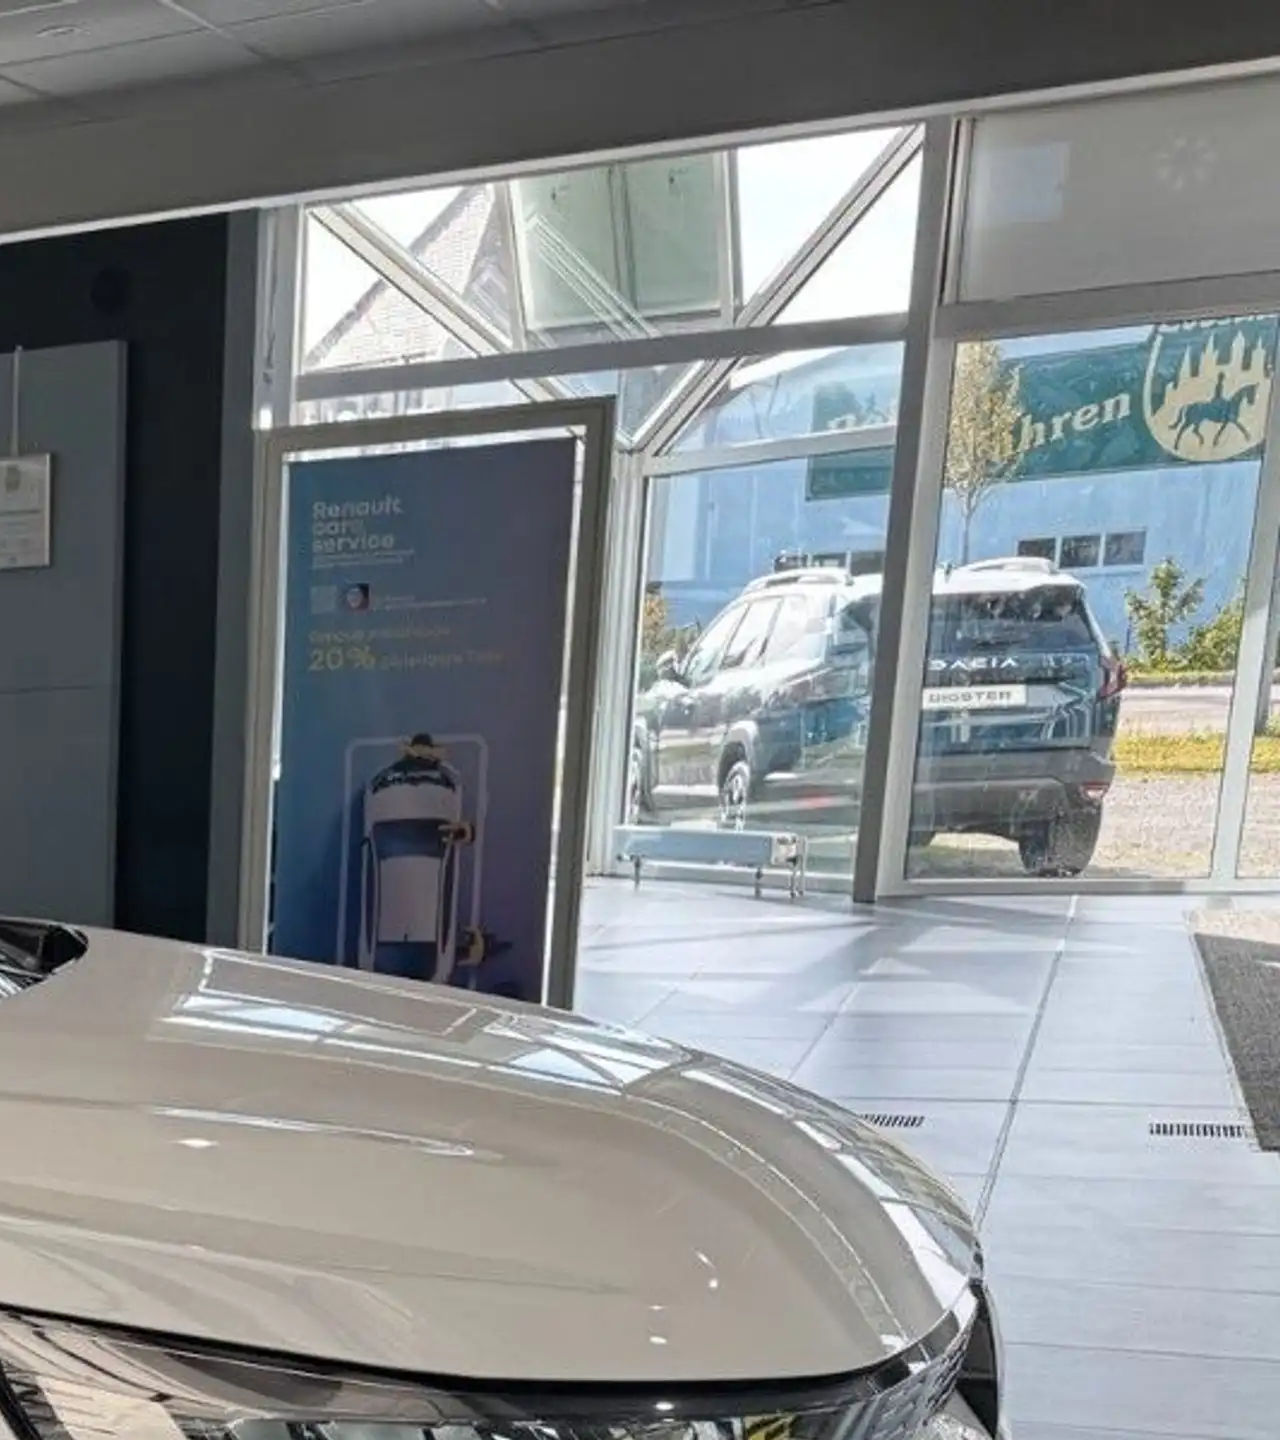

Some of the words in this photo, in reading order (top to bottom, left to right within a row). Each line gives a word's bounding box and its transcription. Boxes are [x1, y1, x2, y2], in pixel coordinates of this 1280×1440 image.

[1016, 392, 1132, 450] hren
[313, 495, 403, 519] Renault
[313, 534, 395, 553] service
